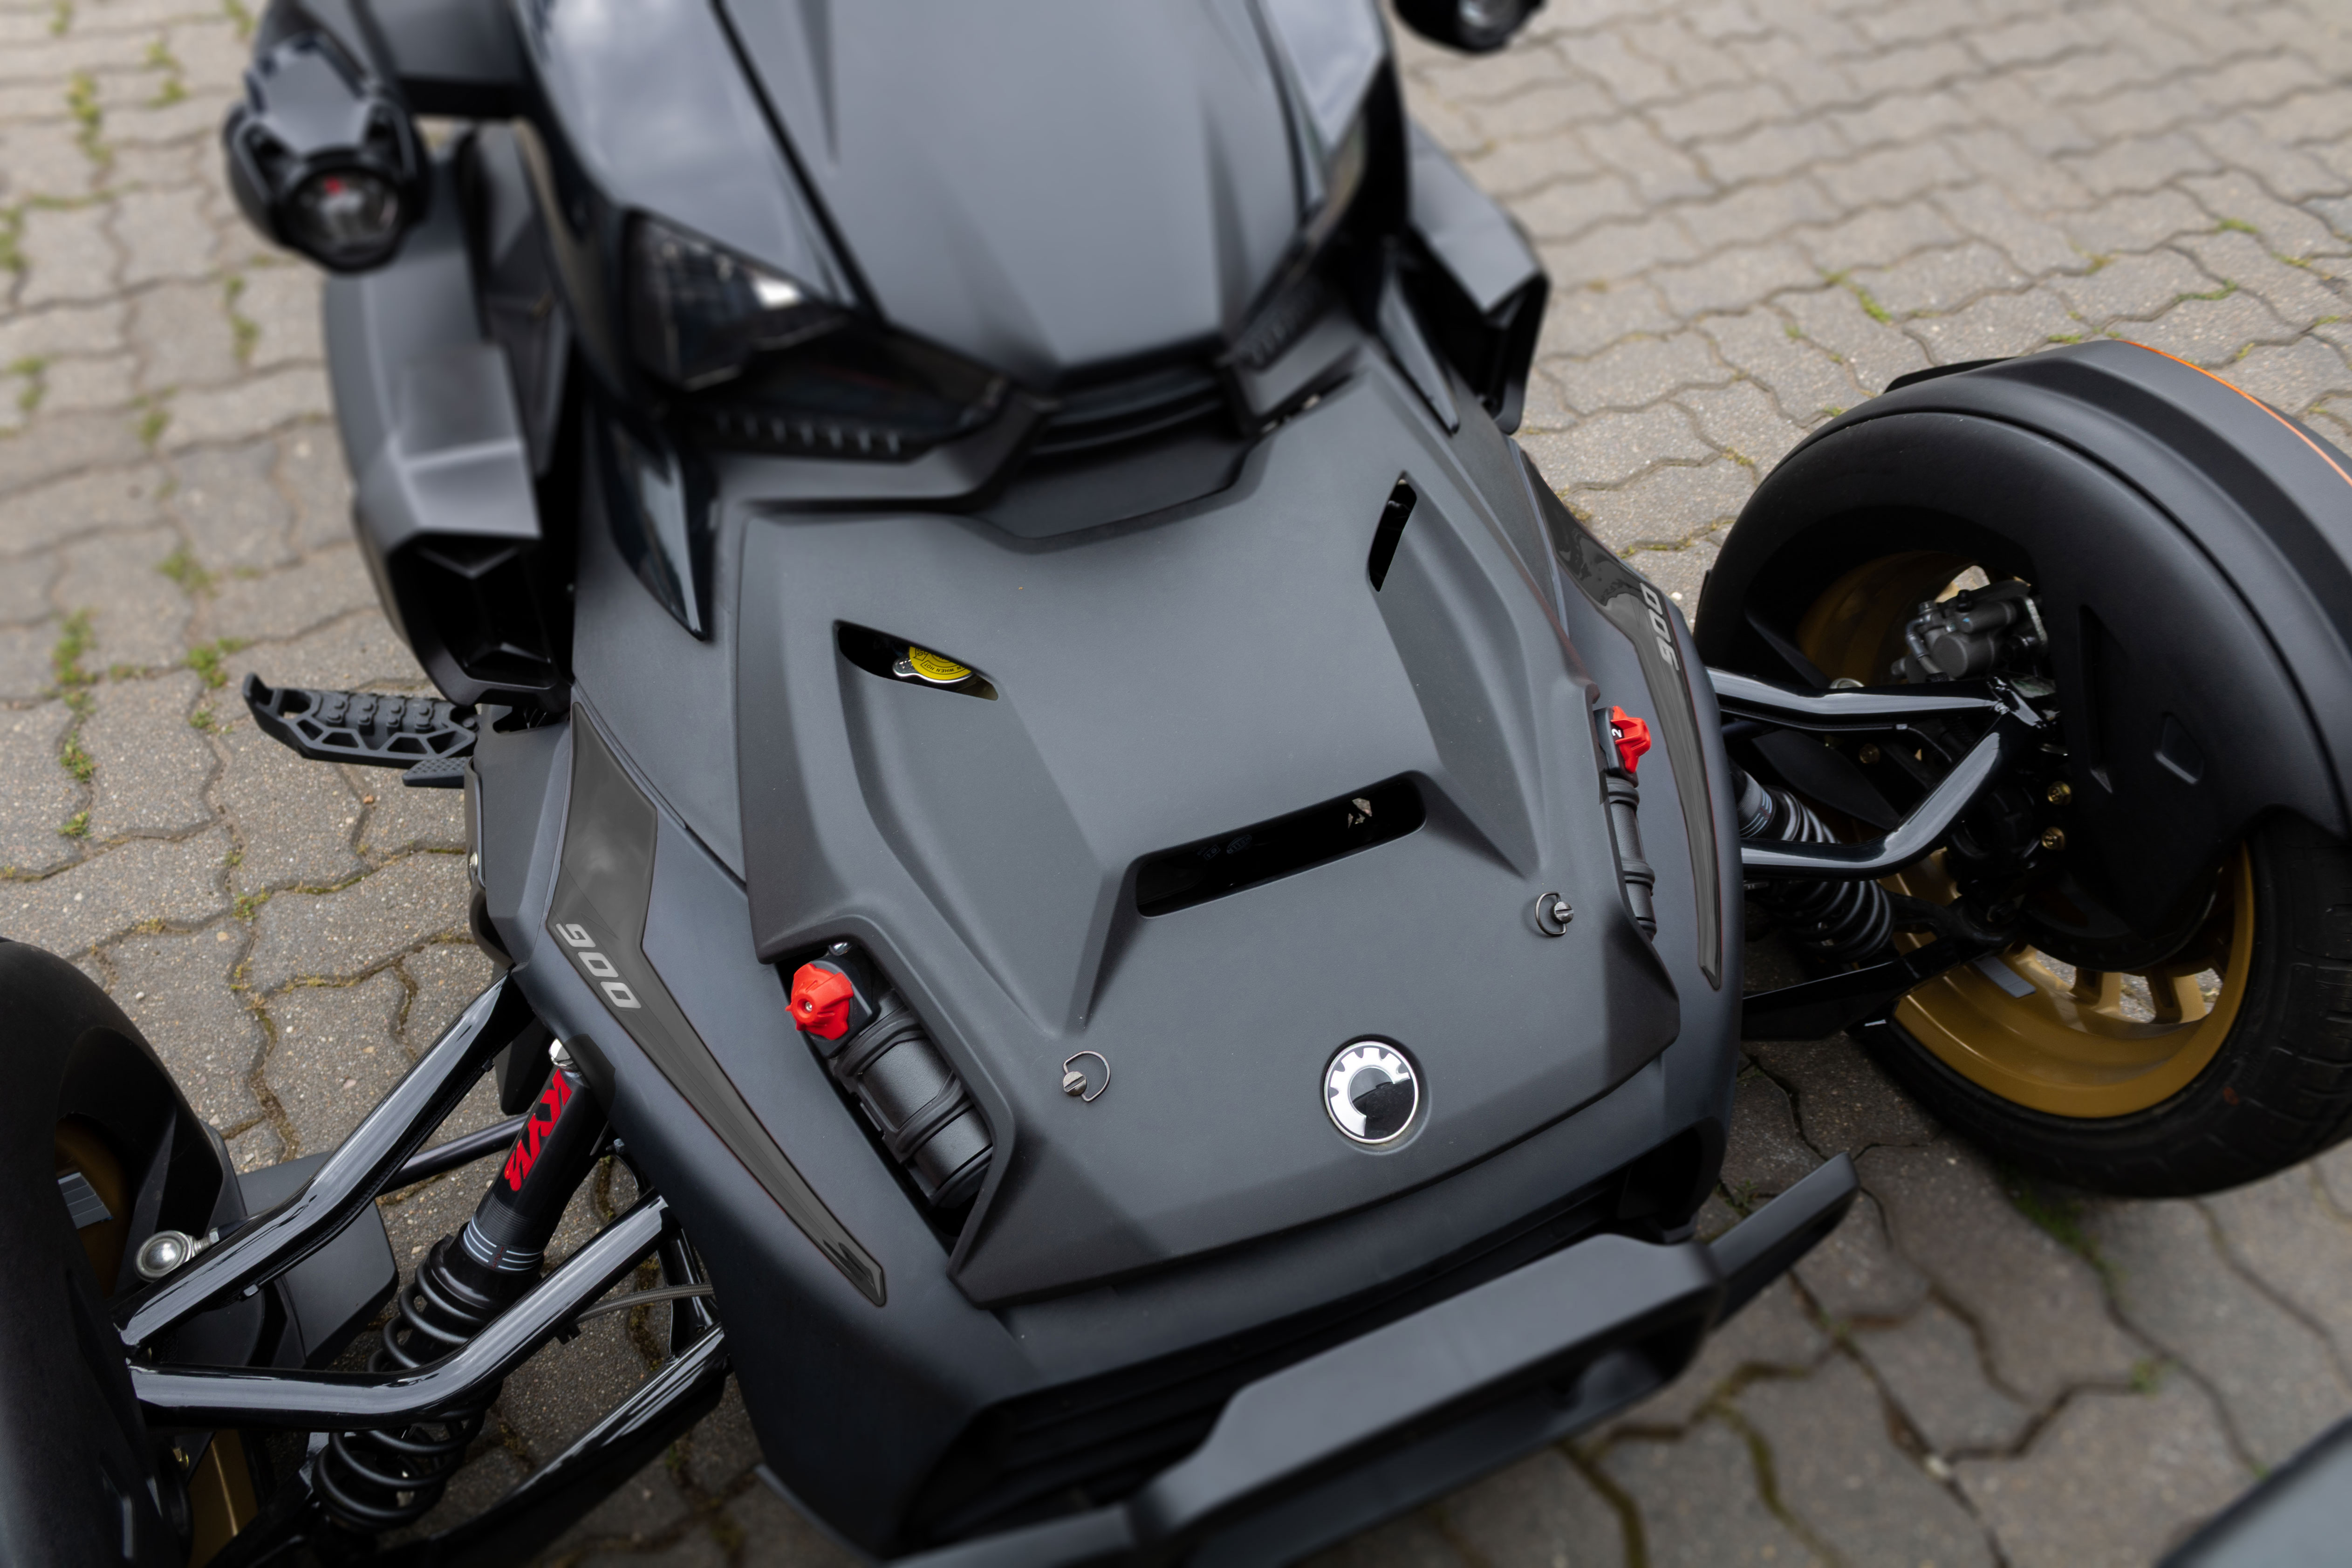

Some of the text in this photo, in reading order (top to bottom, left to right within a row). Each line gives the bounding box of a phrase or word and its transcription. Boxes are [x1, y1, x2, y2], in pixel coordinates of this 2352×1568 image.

[1640, 582, 1679, 671] 900
[1611, 728, 1622, 738] 2
[556, 923, 642, 1008] 900
[504, 1068, 572, 1191] KYB
